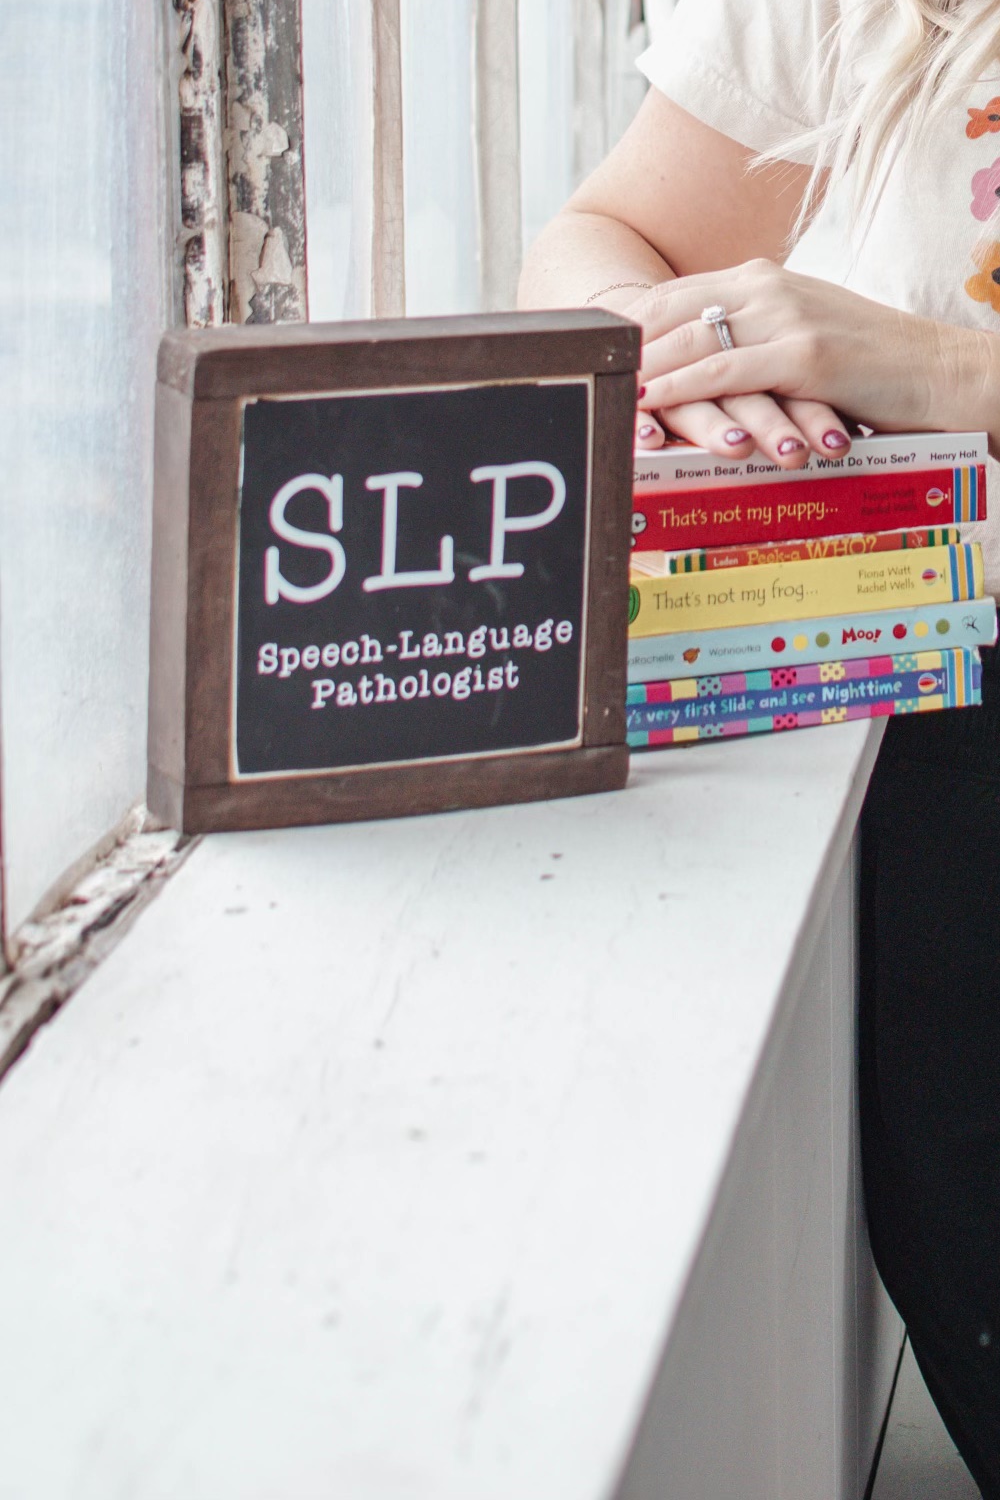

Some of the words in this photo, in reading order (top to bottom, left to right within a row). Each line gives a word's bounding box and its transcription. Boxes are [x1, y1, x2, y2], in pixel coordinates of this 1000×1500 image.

[675, 468, 711, 479] Brown
[714, 465, 743, 476] Bear,
[816, 457, 844, 469] What
[849, 456, 863, 467] Do
[866, 454, 887, 465] You
[890, 452, 916, 464] See?
[930, 451, 956, 462] Henry
[959, 449, 978, 459] Holt
[658, 507, 708, 528] That's
[713, 505, 742, 524] not
[747, 506, 772, 526] my
[777, 500, 839, 522] puppy...
[264, 460, 567, 605] SLP
[805, 535, 877, 559] WHO?
[858, 568, 885, 579] Fiona
[888, 566, 912, 577] Watt
[653, 591, 701, 610] That's
[707, 588, 739, 605] not
[741, 589, 766, 607] my
[772, 578, 818, 602] frog...
[857, 581, 887, 595] Rachel
[890, 578, 915, 590] Wells
[257, 618, 573, 678] Speech-Language
[842, 627, 882, 645] Moo!
[310, 660, 519, 709] Pathologist
[646, 707, 680, 725] very
[684, 700, 716, 718] first
[720, 695, 755, 713] Slide
[759, 691, 787, 709] and
[792, 691, 816, 706] see
[822, 679, 902, 703] Nighttime
